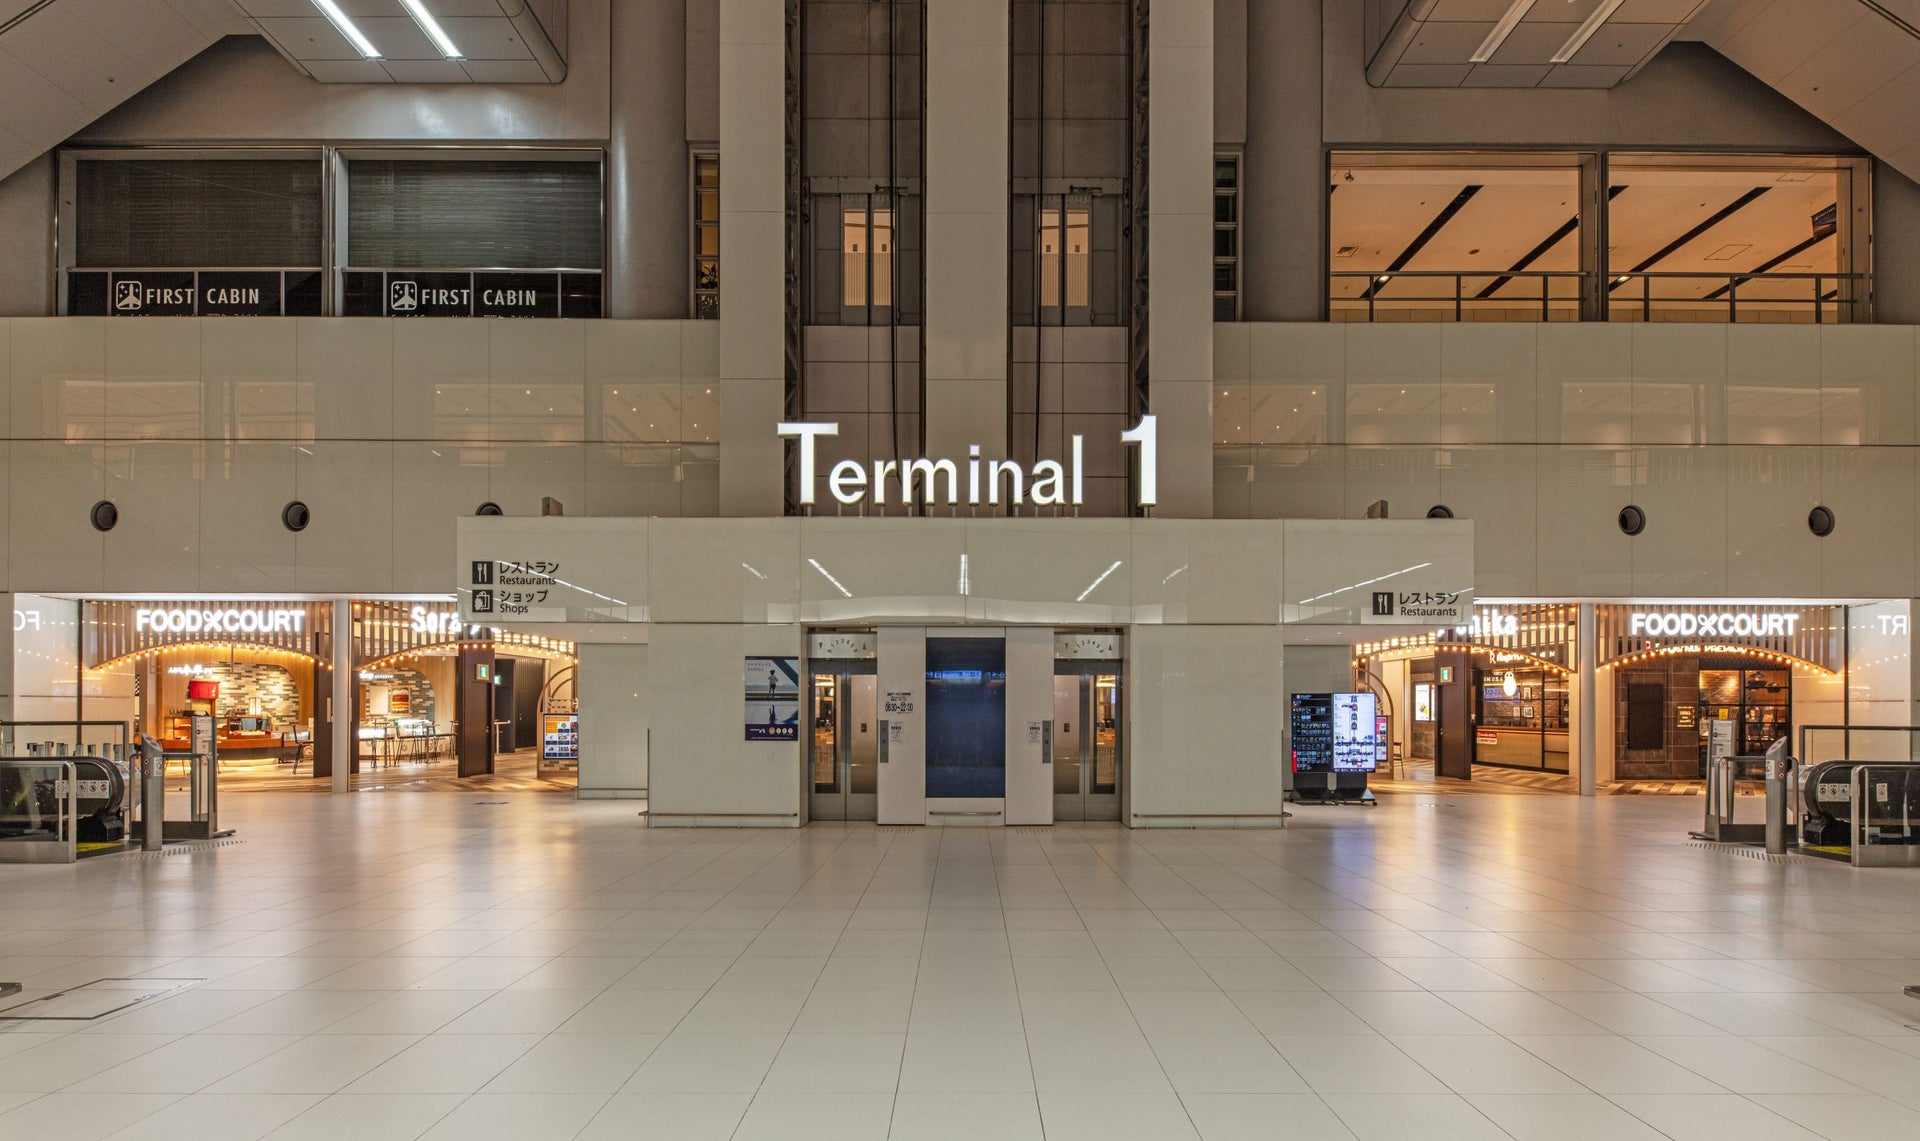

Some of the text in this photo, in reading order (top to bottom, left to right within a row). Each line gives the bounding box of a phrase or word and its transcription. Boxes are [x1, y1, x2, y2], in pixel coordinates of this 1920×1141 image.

[146, 288, 259, 304] FIRST CABIN
[421, 289, 536, 306] FIRST CABIN
[777, 414, 1157, 507] Terminal 1
[499, 561, 559, 574] レストラン
[499, 575, 556, 586] Restaurants
[500, 589, 548, 603] ショップ
[1400, 592, 1459, 605] レストラン
[500, 603, 528, 614] Shops
[1400, 606, 1457, 617] Restaurants
[136, 609, 305, 632] FOOD COURT
[1631, 613, 1799, 635] FOOD COURT
